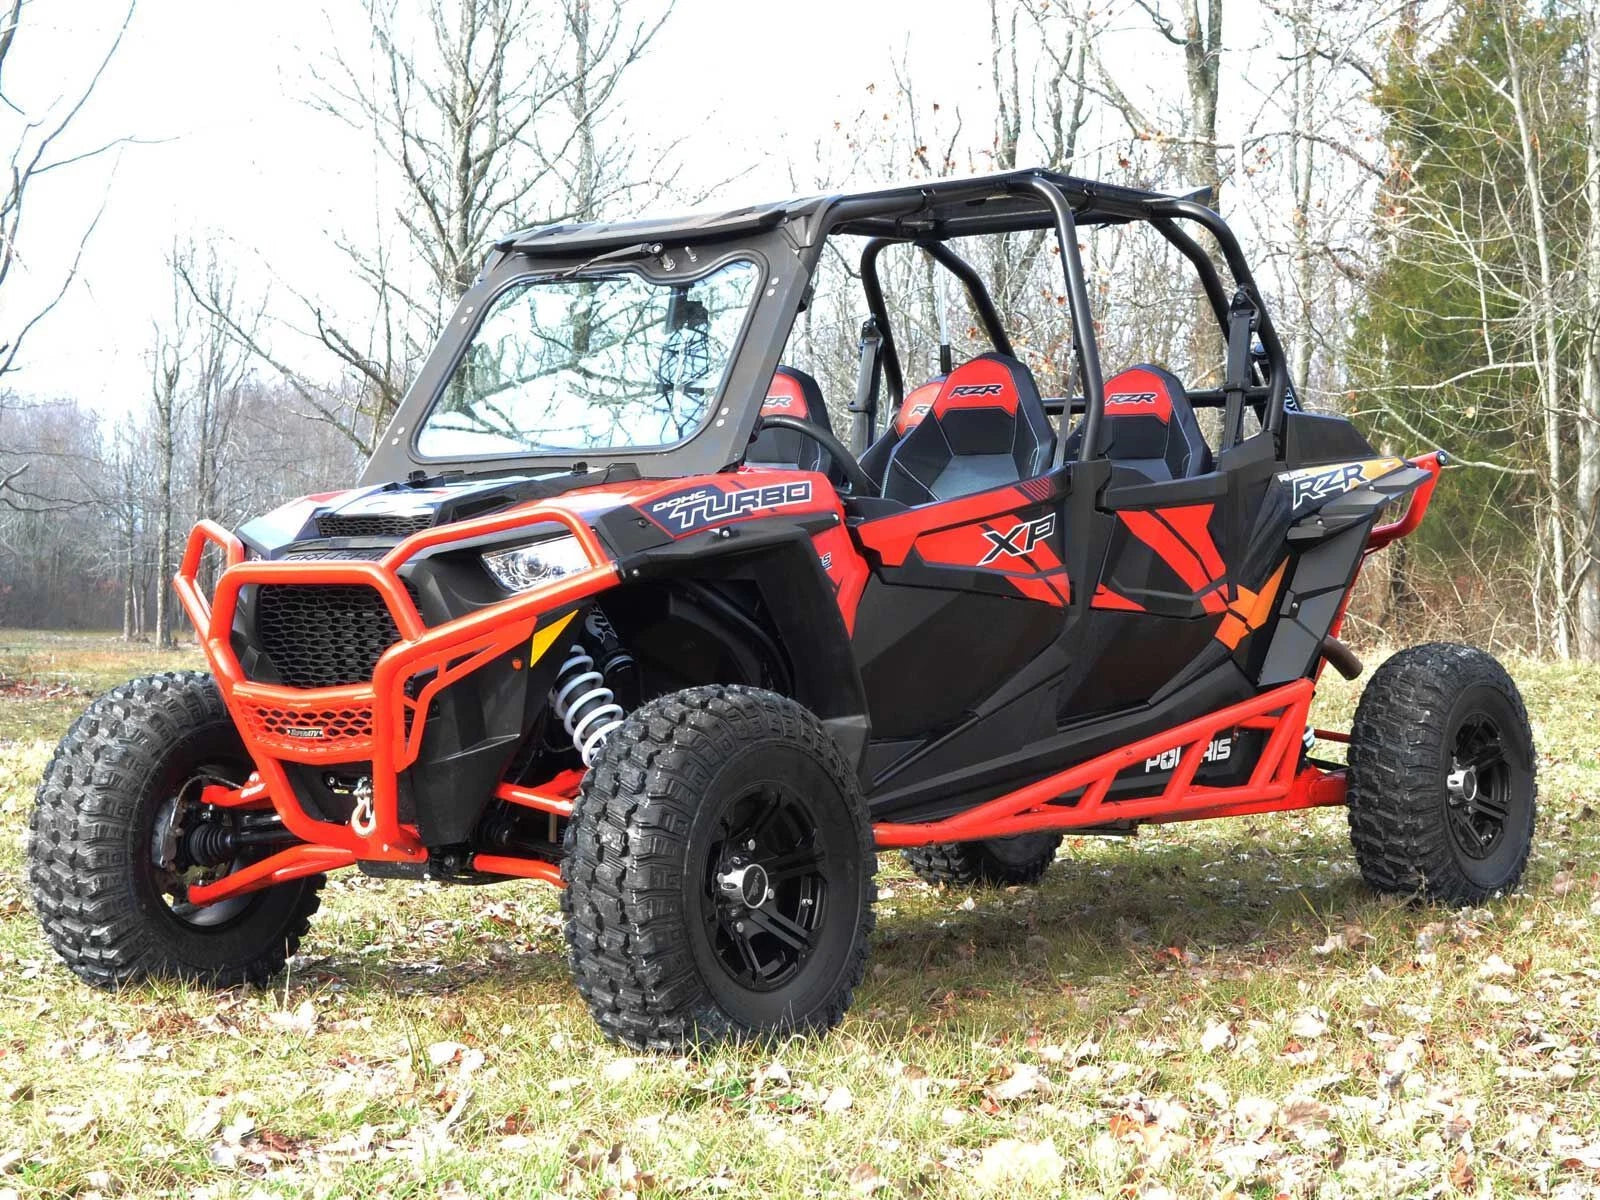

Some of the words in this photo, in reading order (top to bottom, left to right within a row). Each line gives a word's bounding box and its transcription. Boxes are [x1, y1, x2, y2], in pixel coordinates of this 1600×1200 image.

[763, 395, 793, 408] ZR
[947, 383, 1004, 399] RZR
[1104, 391, 1158, 406] RZR
[652, 489, 707, 512] DOHC
[1293, 461, 1371, 511] RZR
[668, 480, 812, 529] TURBO
[976, 512, 1056, 566] XP
[1145, 738, 1231, 773] POLRIS
